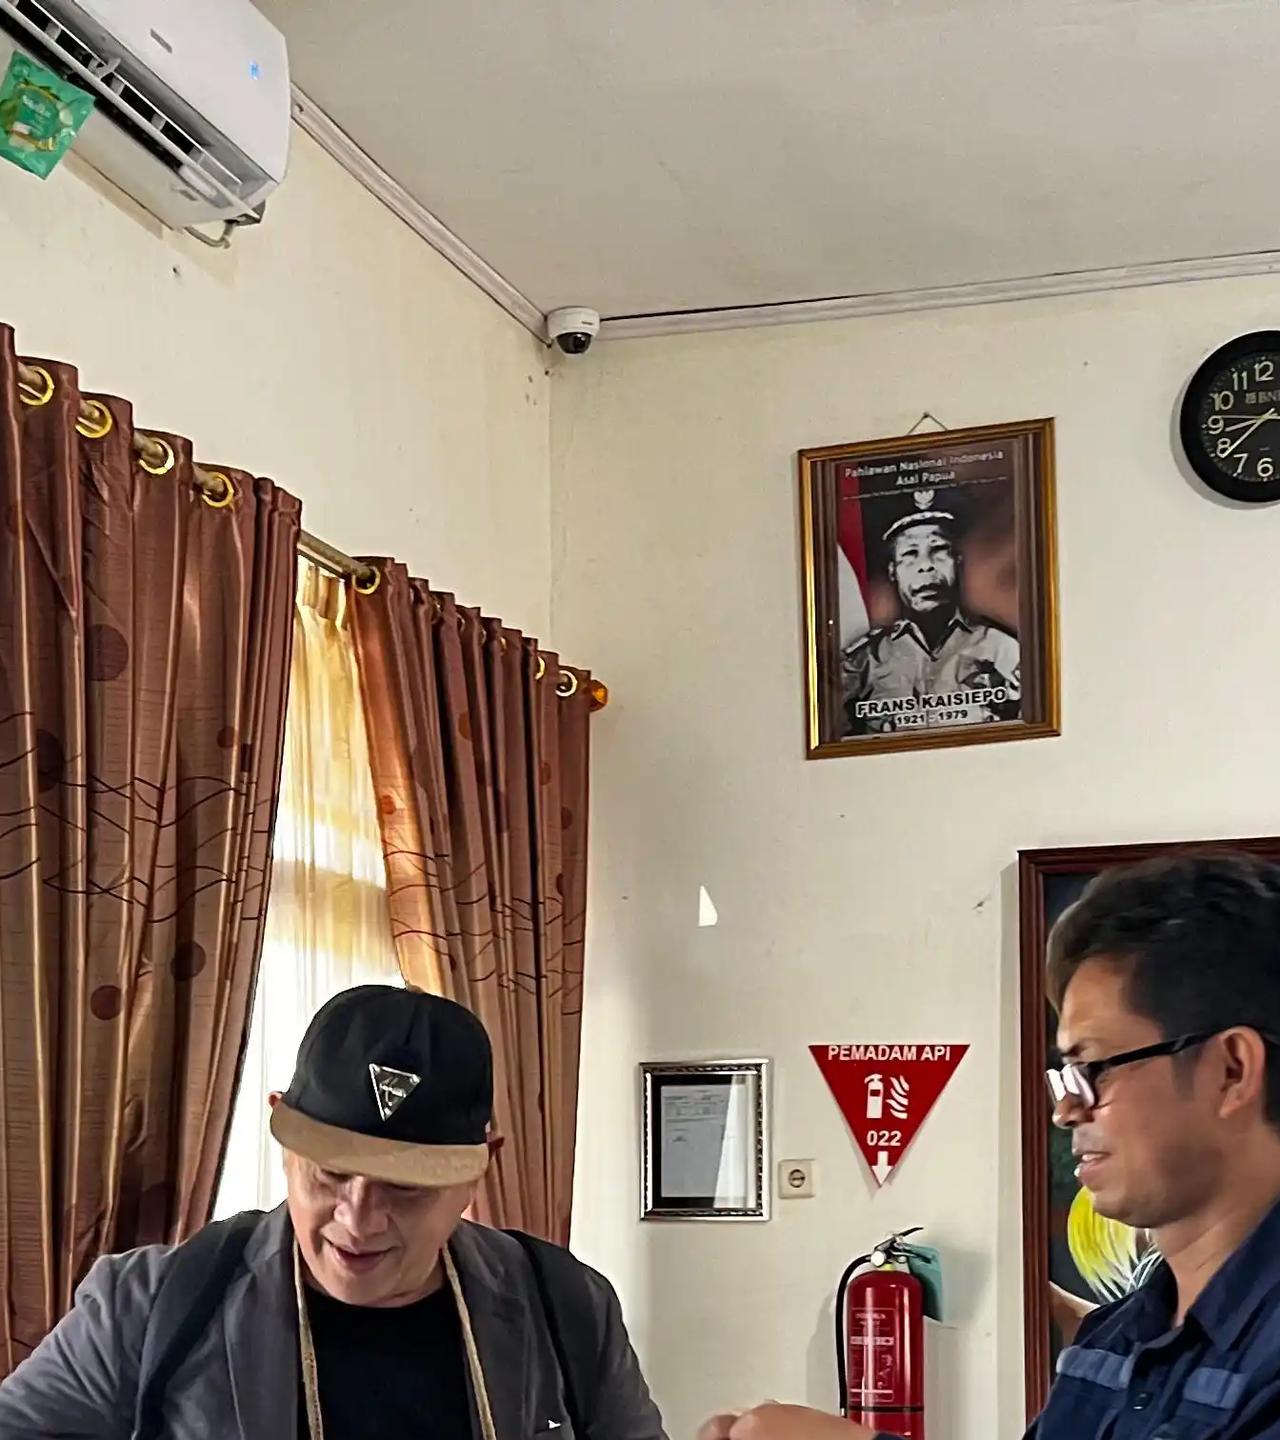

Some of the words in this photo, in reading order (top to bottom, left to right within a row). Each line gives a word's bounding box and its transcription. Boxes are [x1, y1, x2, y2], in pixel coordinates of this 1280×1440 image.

[1231, 371, 1248, 391] 11
[1254, 361, 1275, 382] 12
[1209, 390, 1234, 411] 10
[1207, 415, 1225, 435] 9
[1216, 438, 1232, 459] 8
[845, 463, 897, 478] Pahlawan
[1233, 453, 1248, 474] 7
[1256, 457, 1274, 477] 6
[857, 699, 916, 717] FRANS
[921, 688, 1007, 709] KAISIEPO
[896, 714, 926, 726] 1921
[938, 709, 969, 722] 1979
[827, 1045, 917, 1061] PEMADAM
[920, 1045, 951, 1061] API
[866, 1130, 902, 1147] 022
